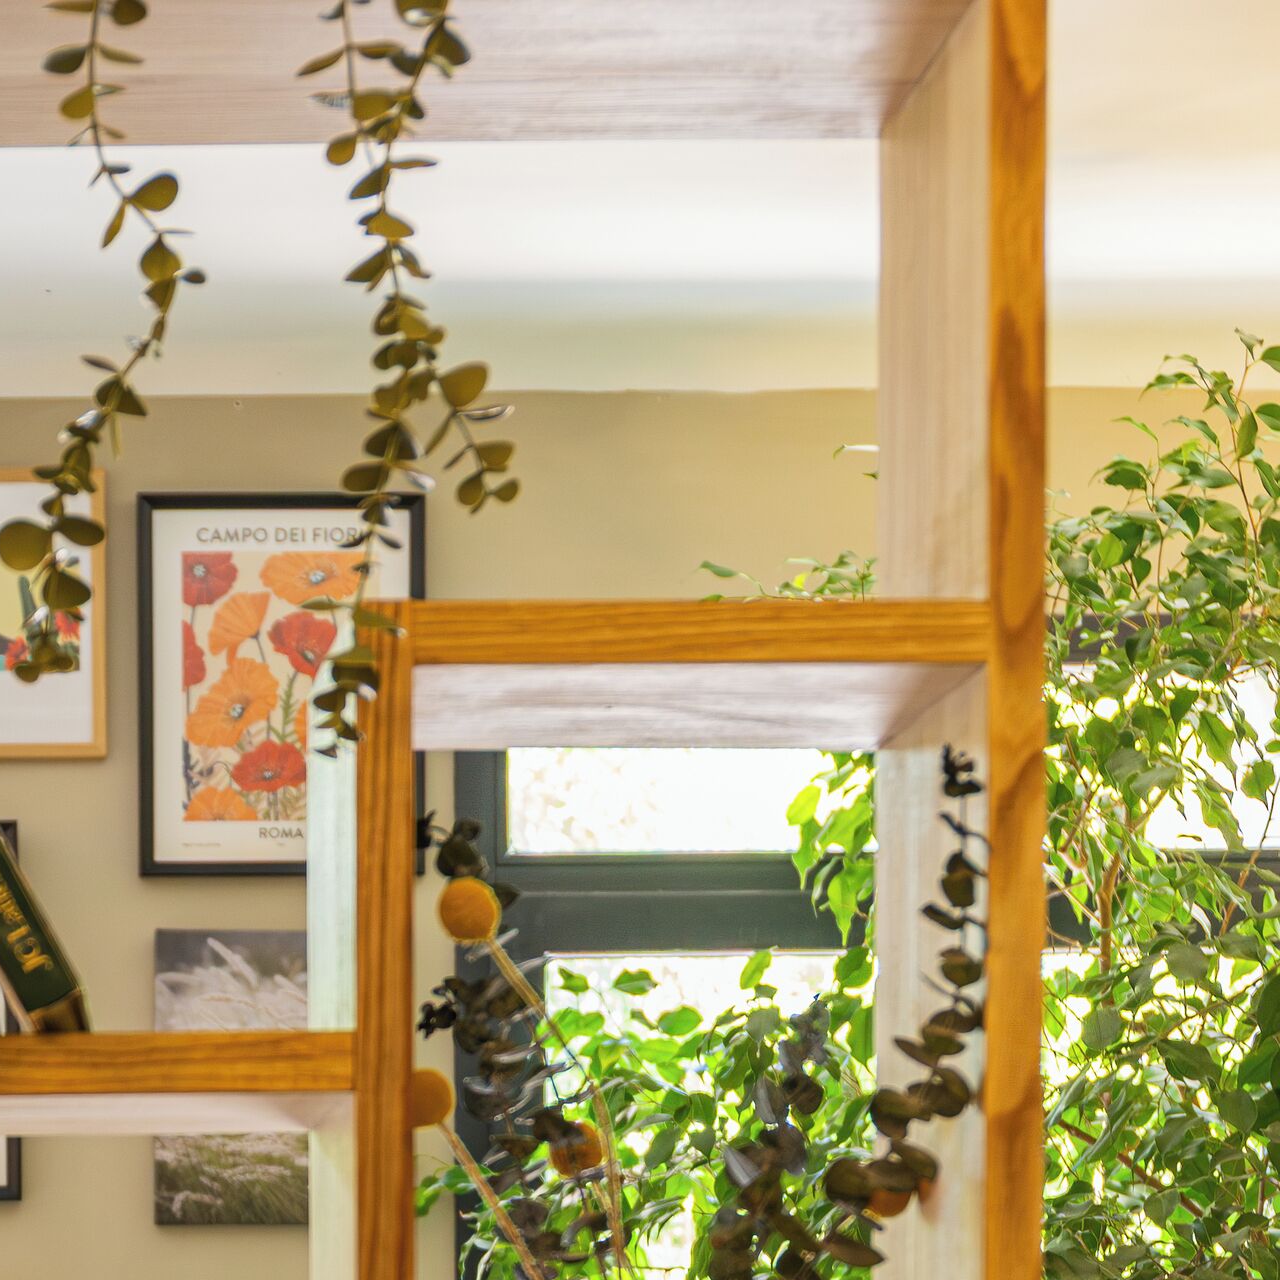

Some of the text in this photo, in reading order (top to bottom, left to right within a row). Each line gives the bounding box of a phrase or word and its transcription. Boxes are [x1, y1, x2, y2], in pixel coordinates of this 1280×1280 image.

[196, 526, 366, 544] CAMPO DEI FIOR
[259, 827, 304, 839] ROMA
